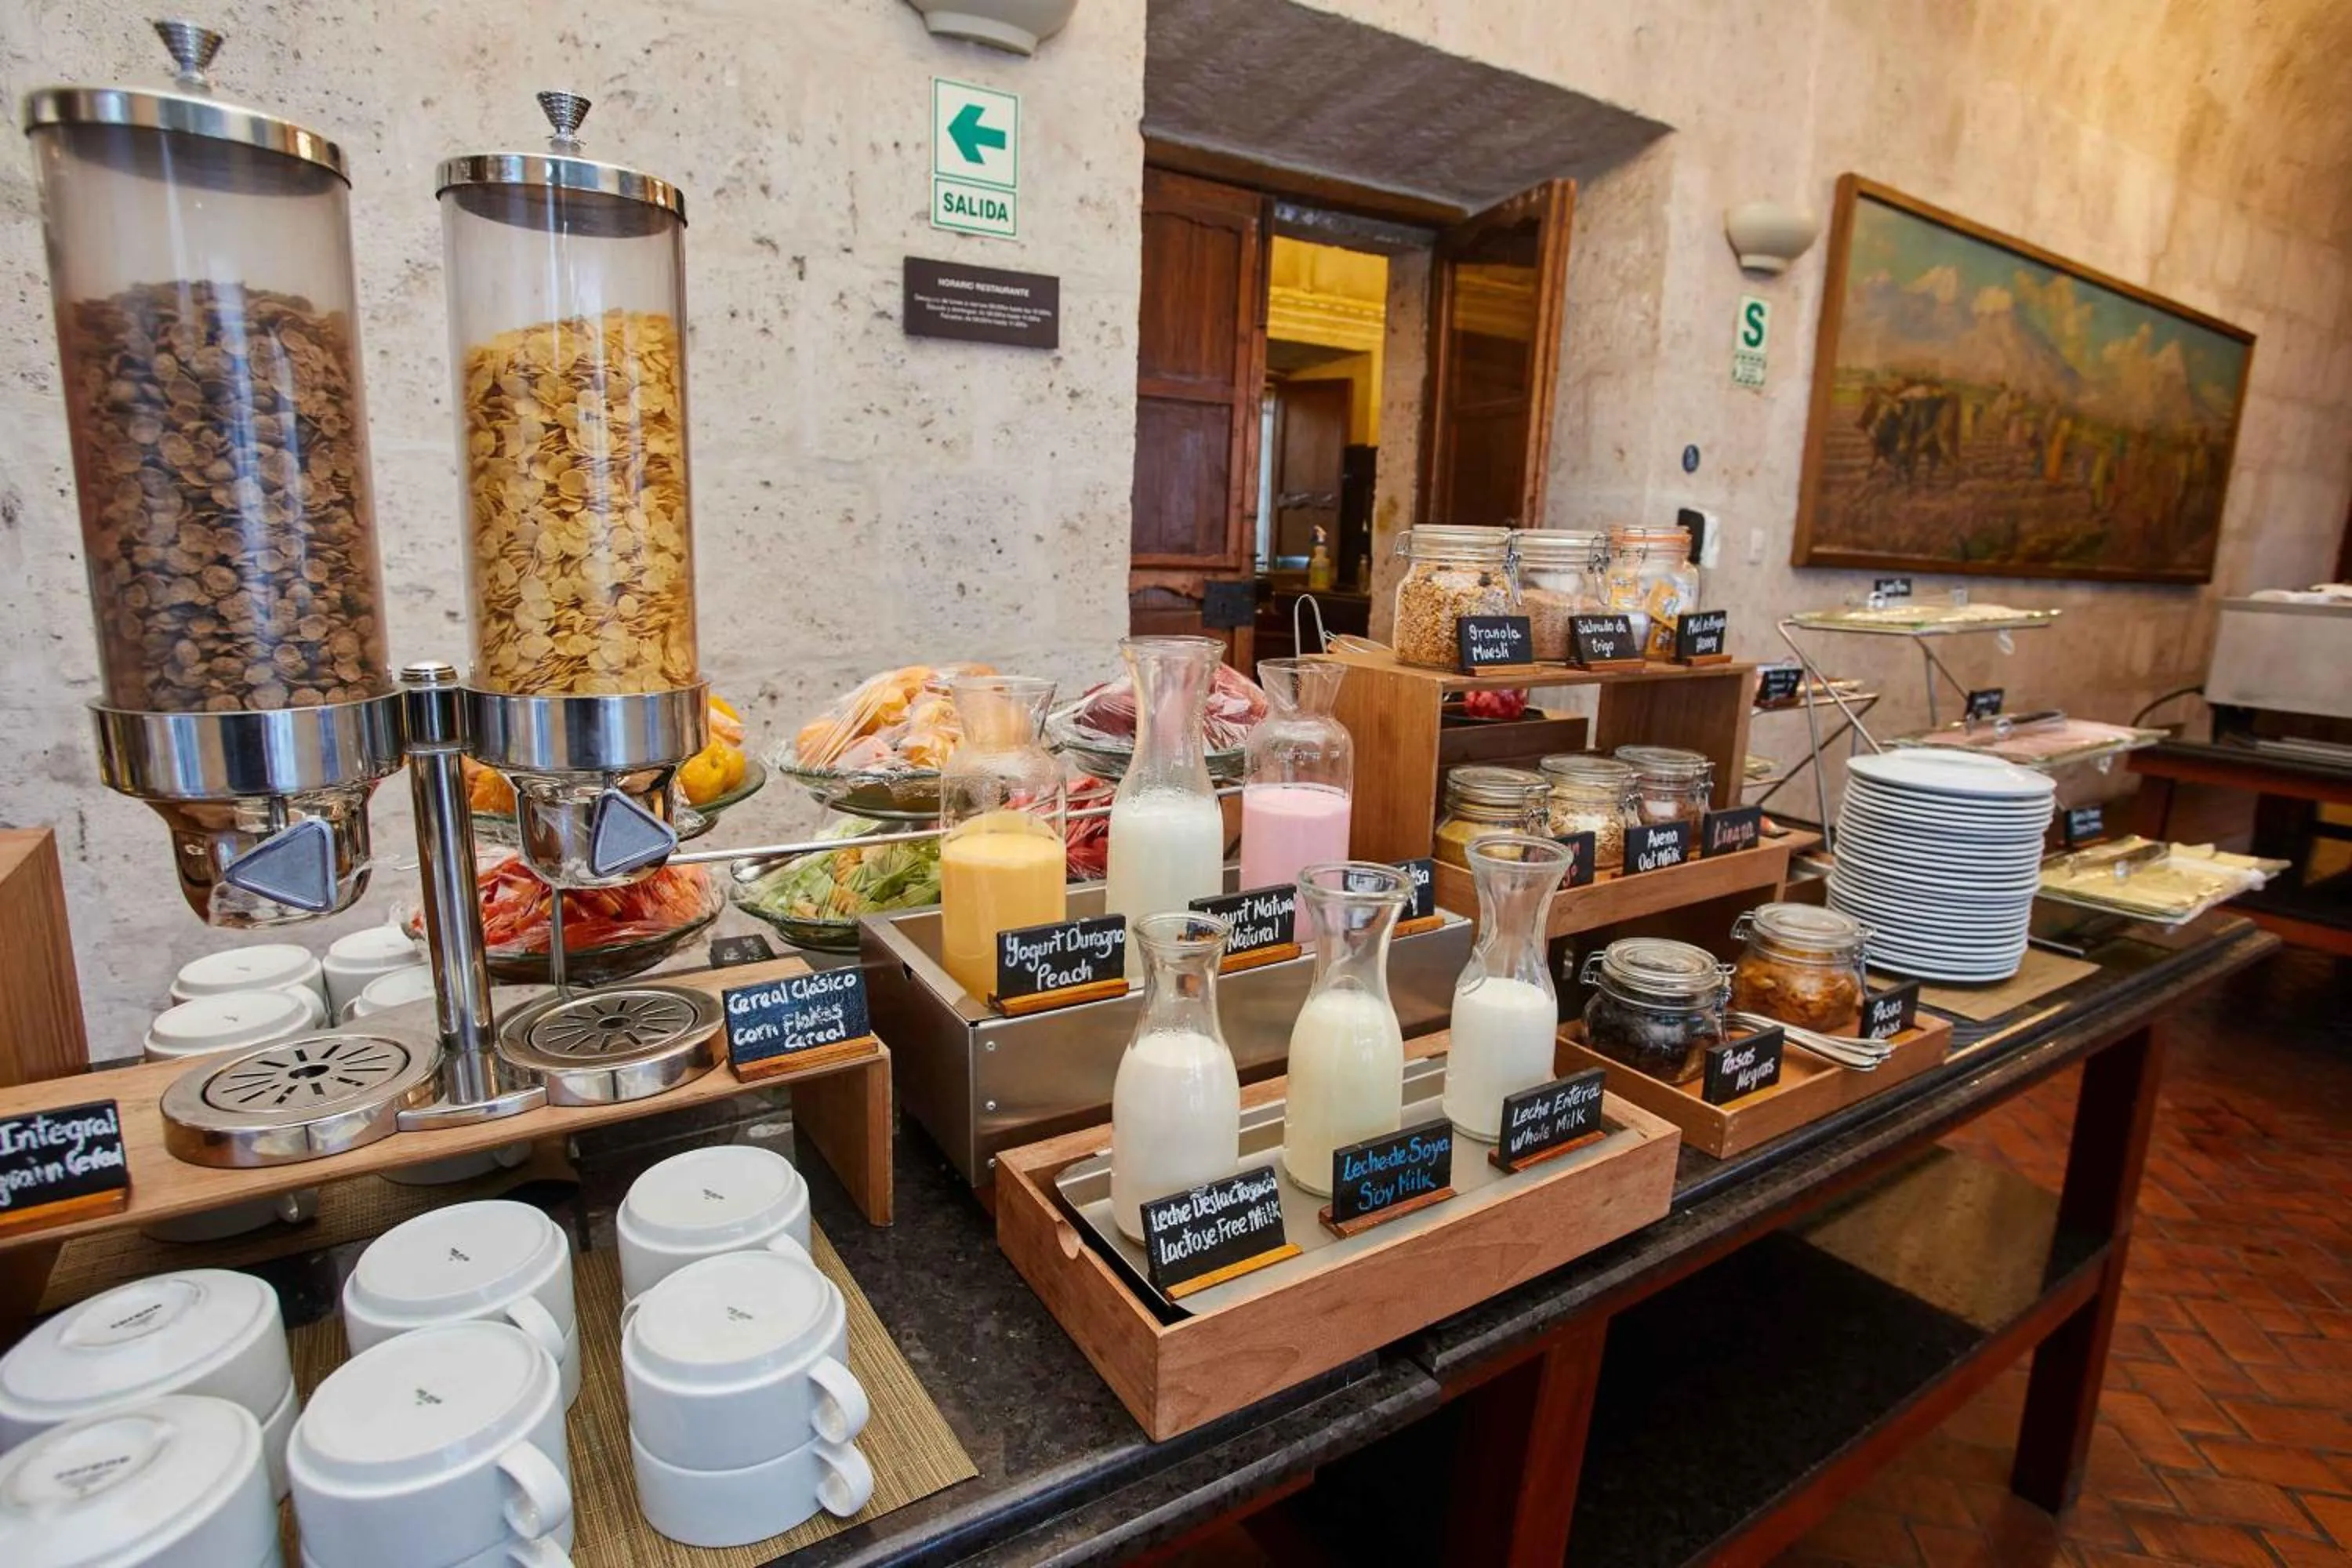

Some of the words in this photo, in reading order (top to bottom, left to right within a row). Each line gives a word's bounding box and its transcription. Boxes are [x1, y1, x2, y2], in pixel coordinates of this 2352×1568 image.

[943, 192, 1008, 223] SALIDA
[1743, 301, 1765, 347] S
[1005, 930, 1065, 972] Yogurt
[1066, 921, 1126, 959] Durazno
[1227, 917, 1279, 953] Natural
[1036, 958, 1094, 991] Peach
[728, 981, 789, 1014] Cereal
[1512, 1098, 1552, 1128] Leche
[0, 1108, 118, 1156] Integral
[1357, 1178, 1396, 1210] Soy
[1150, 1203, 1192, 1232] Leche
[1160, 1225, 1219, 1265] Lactose
[1216, 1217, 1247, 1243] Free
